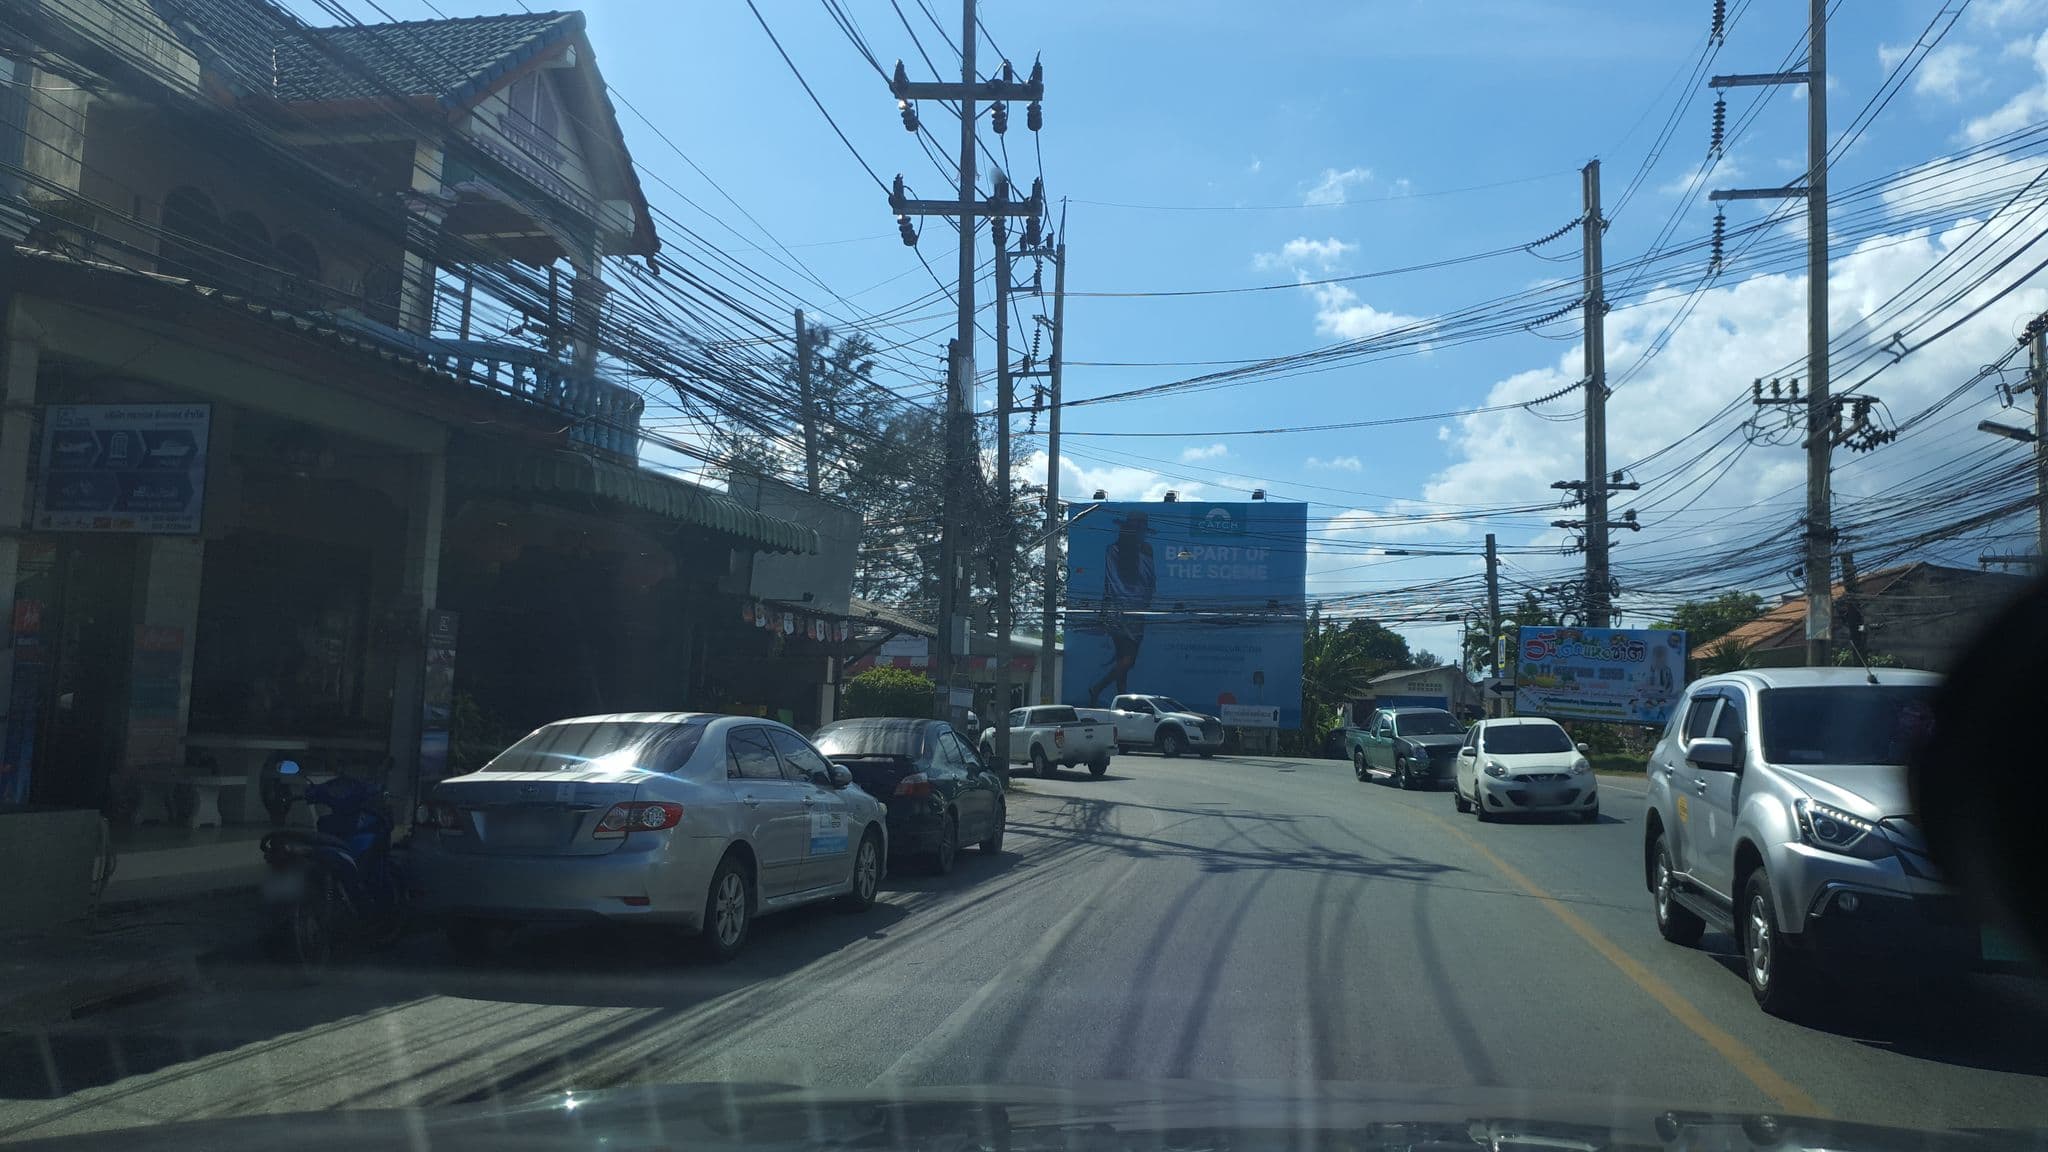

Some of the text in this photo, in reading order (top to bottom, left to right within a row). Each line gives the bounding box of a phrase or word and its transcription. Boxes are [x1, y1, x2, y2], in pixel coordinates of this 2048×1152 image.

[1199, 521, 1238, 529] CATCH
[1193, 545, 1239, 560] PART
[1167, 564, 1267, 578] THE SCENE
